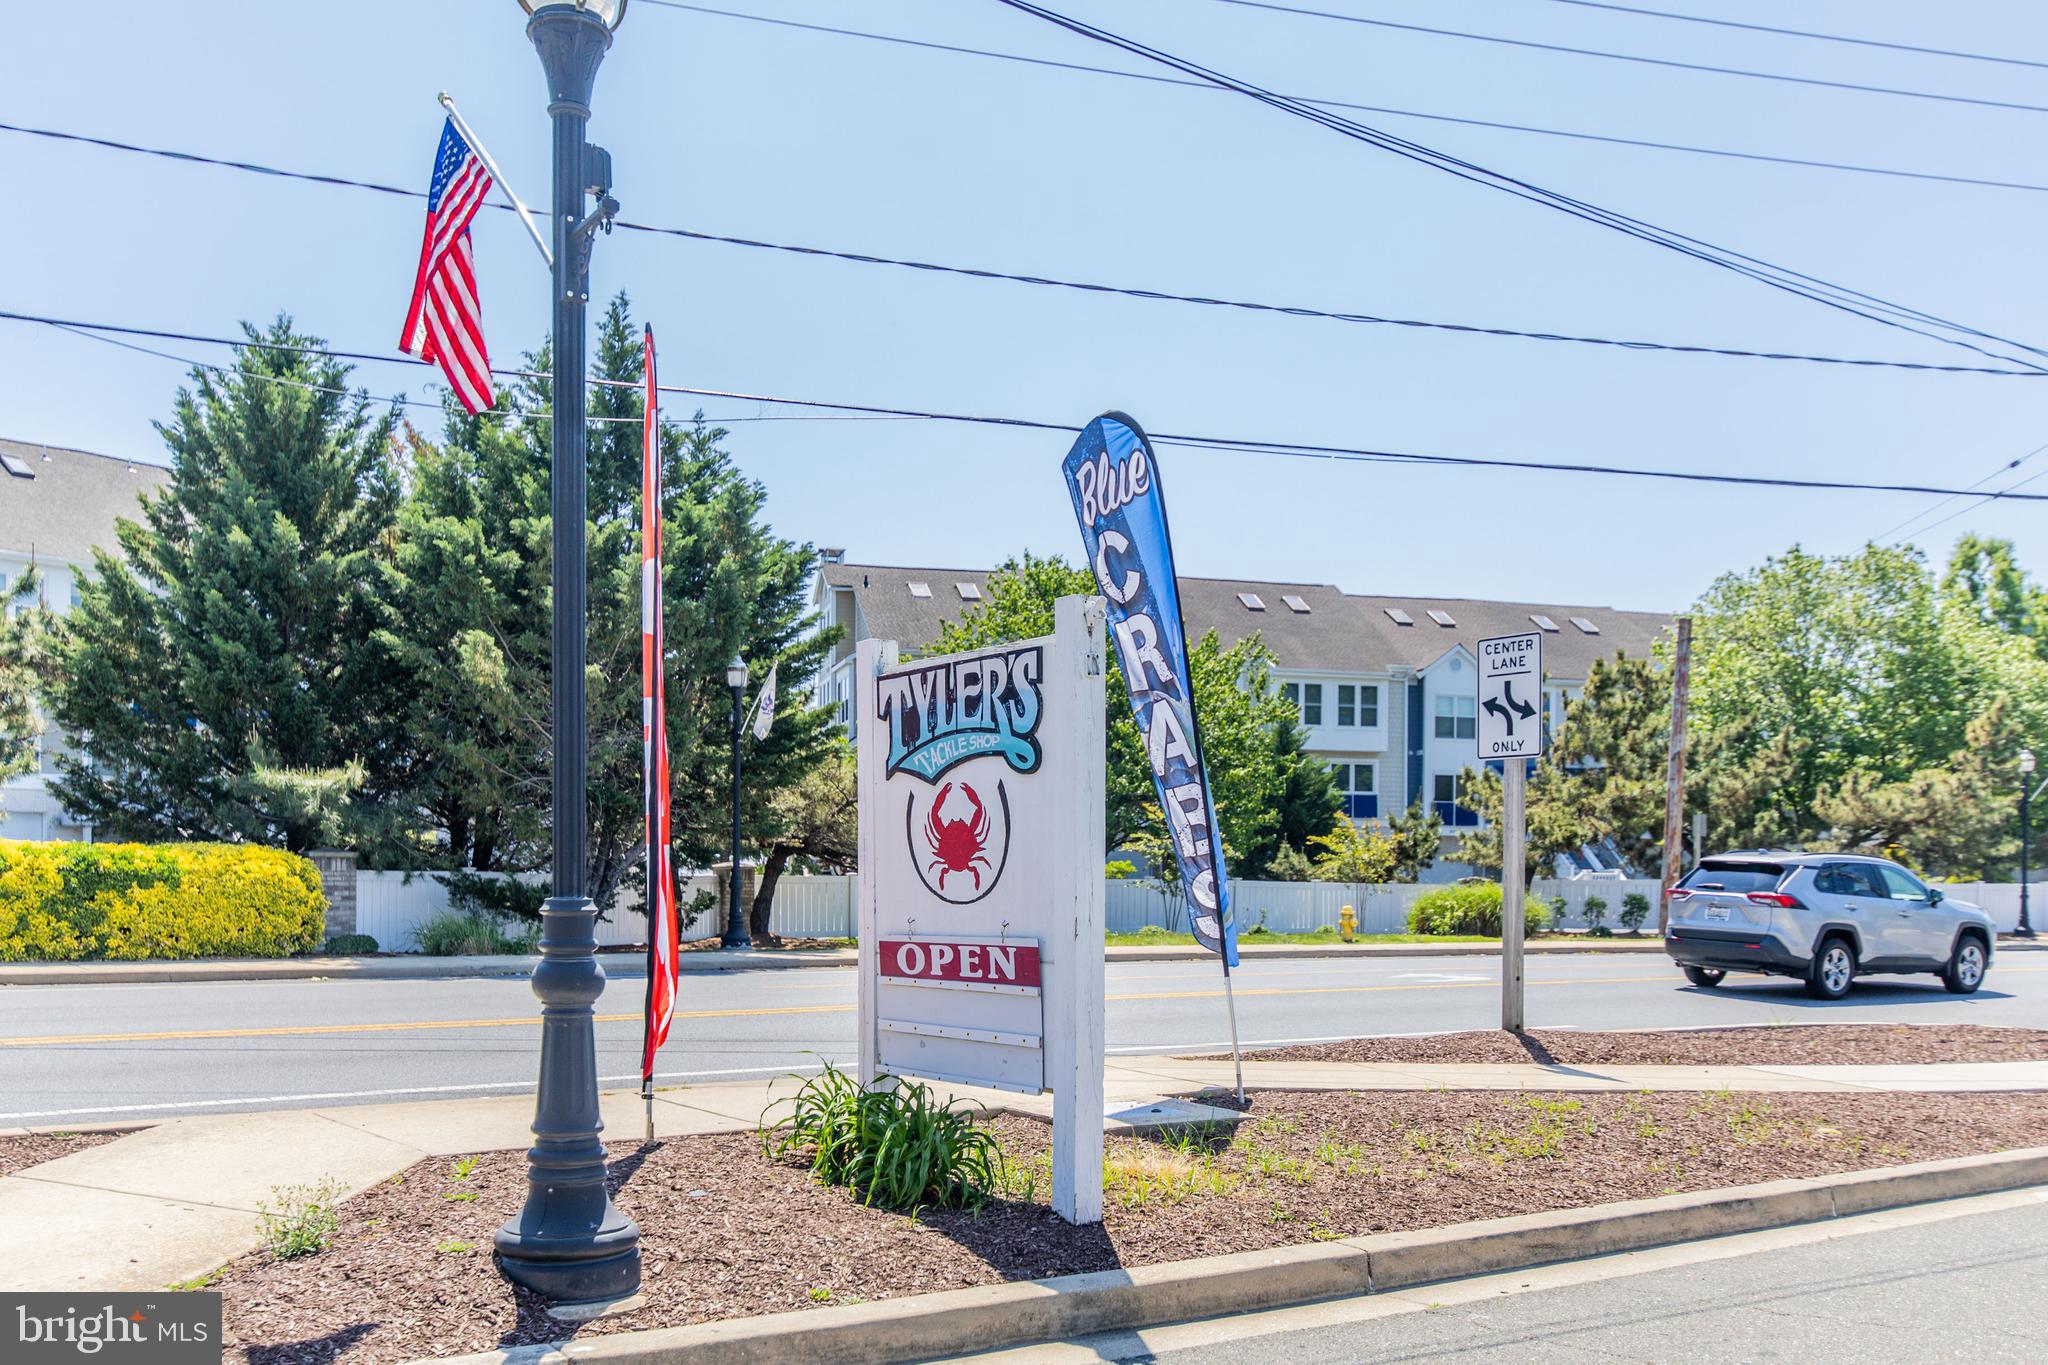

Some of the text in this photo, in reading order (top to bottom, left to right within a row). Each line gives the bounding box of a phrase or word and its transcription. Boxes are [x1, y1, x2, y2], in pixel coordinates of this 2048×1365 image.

[1074, 449, 1150, 527] Blue
[1485, 639, 1533, 656] CENTER
[1492, 655, 1526, 670] LANE
[878, 648, 1040, 772] TYLER'S
[913, 734, 1001, 775] TACKLE SHOP
[1492, 740, 1525, 752] ONLY
[896, 943, 1017, 980] OPEN
